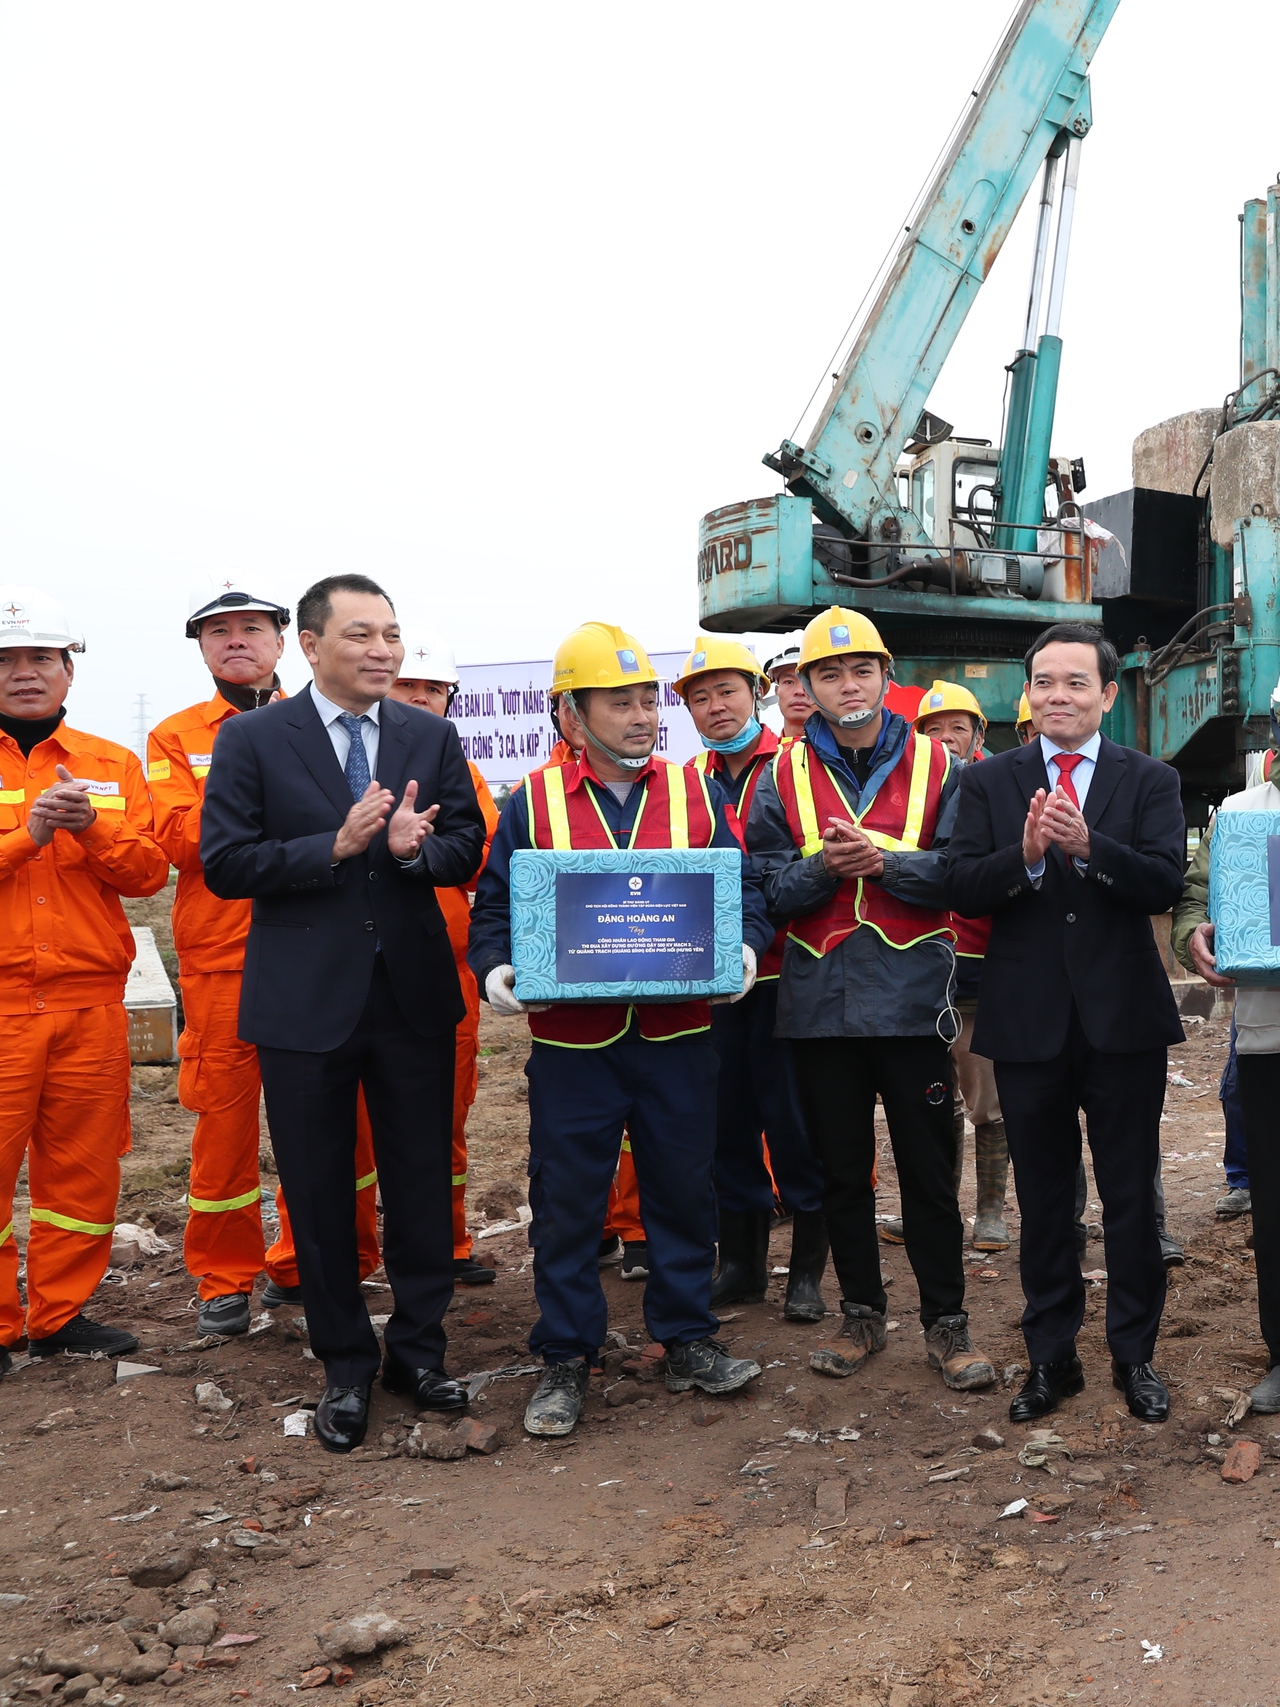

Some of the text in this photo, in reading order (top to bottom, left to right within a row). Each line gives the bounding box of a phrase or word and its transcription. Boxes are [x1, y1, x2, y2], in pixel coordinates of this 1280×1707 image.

[464, 688, 480, 718] BÀN
[482, 688, 496, 719] LÙI,
[522, 681, 544, 714] NẮNG
[472, 730, 493, 760] CÔNG
[506, 734, 518, 761] CA,
[520, 734, 524, 758] 4
[598, 914, 624, 924] ĐẶNG
[627, 913, 660, 922] HOÀNG
